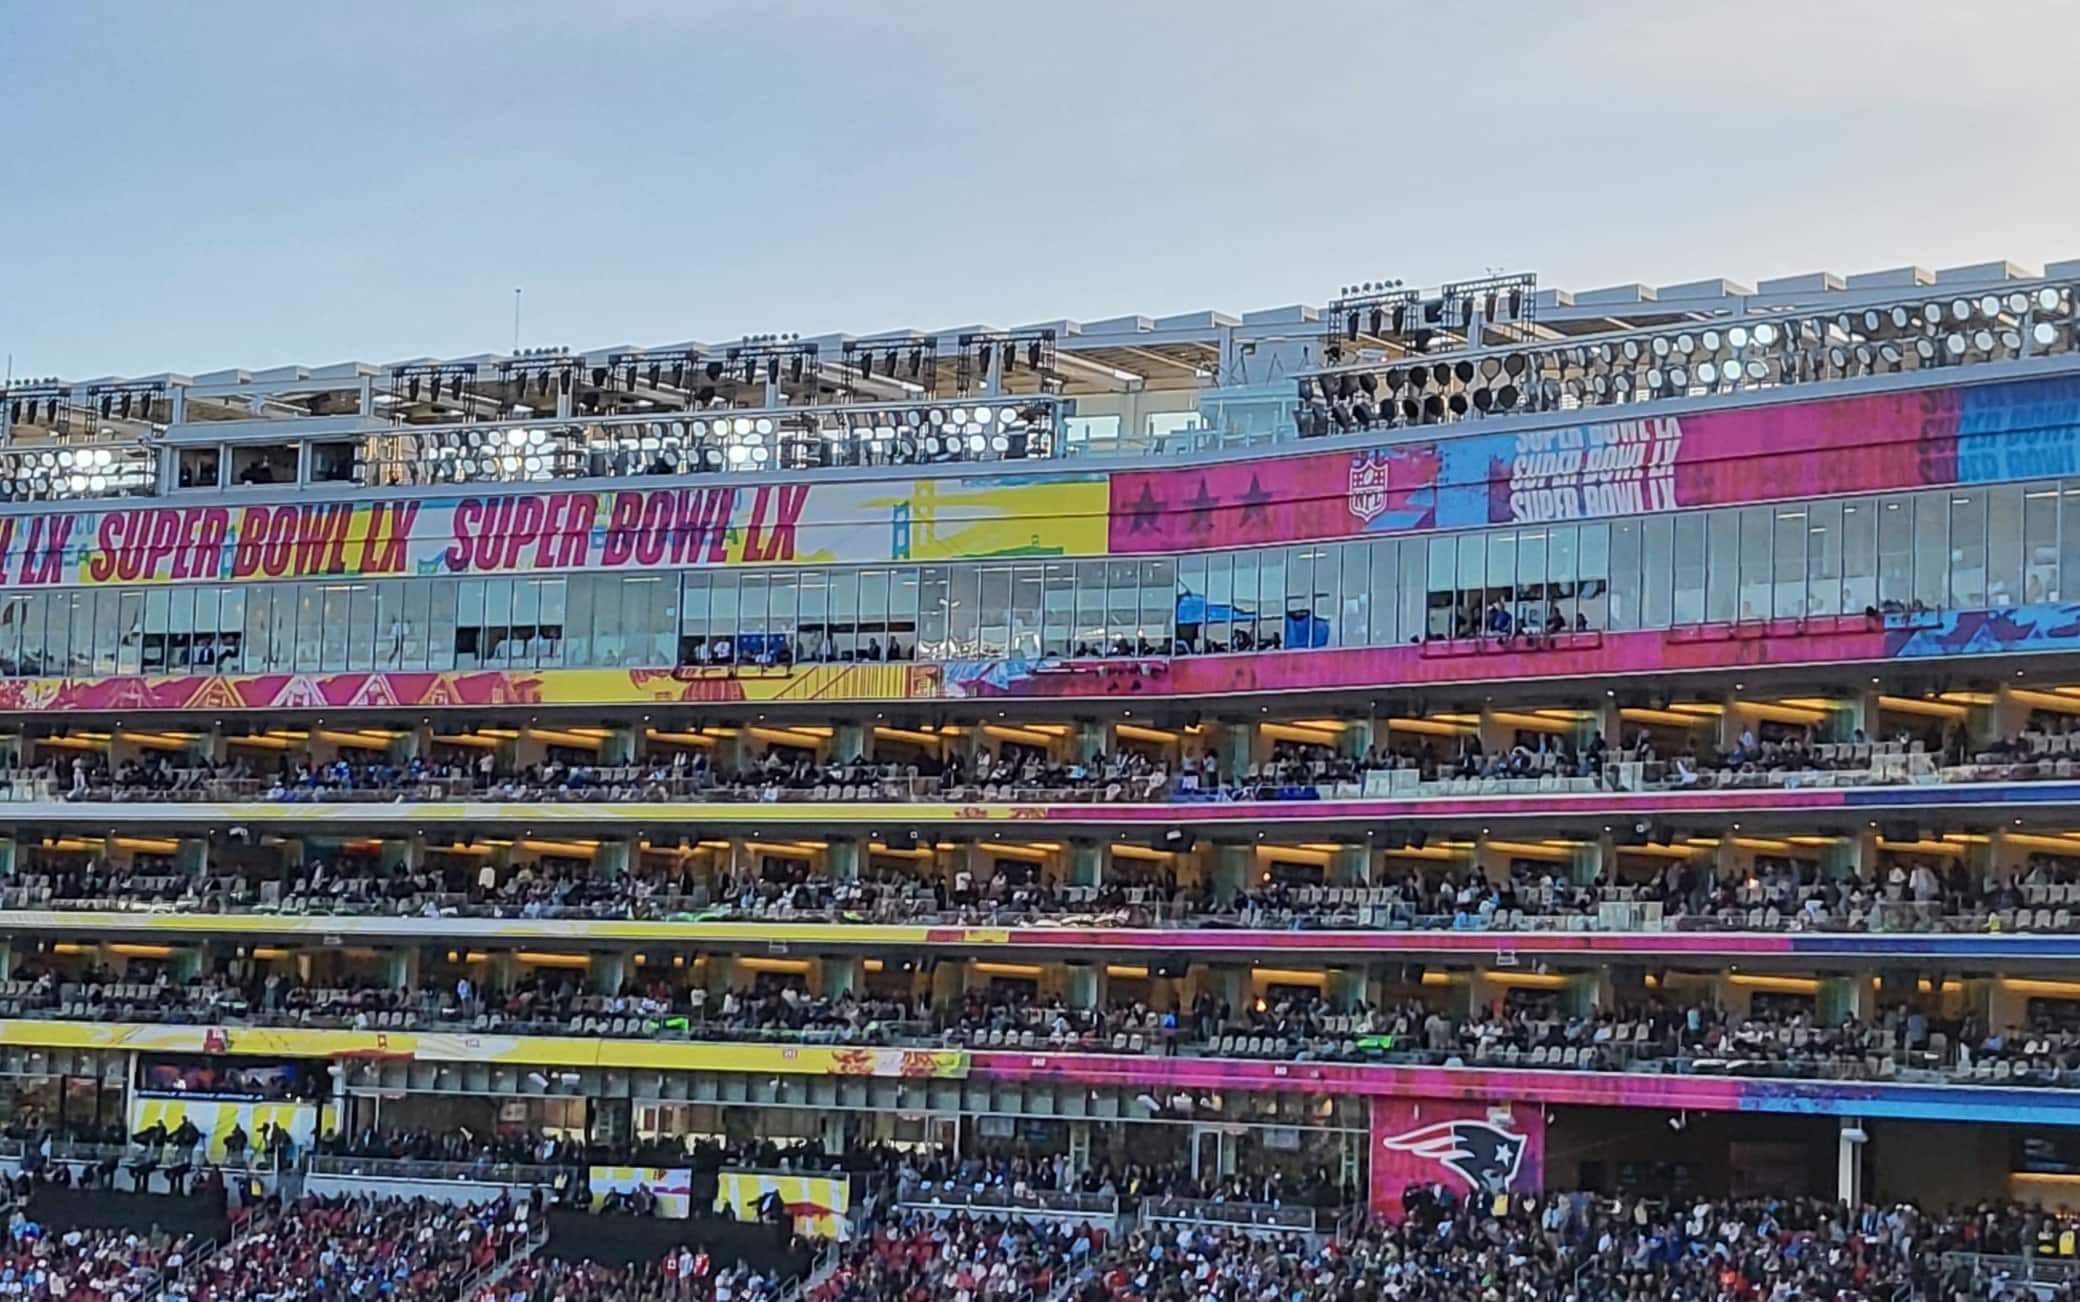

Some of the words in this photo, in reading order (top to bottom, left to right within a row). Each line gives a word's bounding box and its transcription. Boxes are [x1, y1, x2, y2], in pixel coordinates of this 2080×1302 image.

[1510, 450, 1582, 489] SUPER
[1583, 443, 1647, 484] BOWL
[1649, 438, 1681, 477] LX
[20, 513, 75, 584] LX
[91, 506, 230, 582] SUPER
[232, 502, 354, 577] BOWL
[358, 500, 421, 573] LX
[445, 494, 598, 572] SUPER
[602, 487, 736, 566] BOWL
[742, 484, 811, 561] LX
